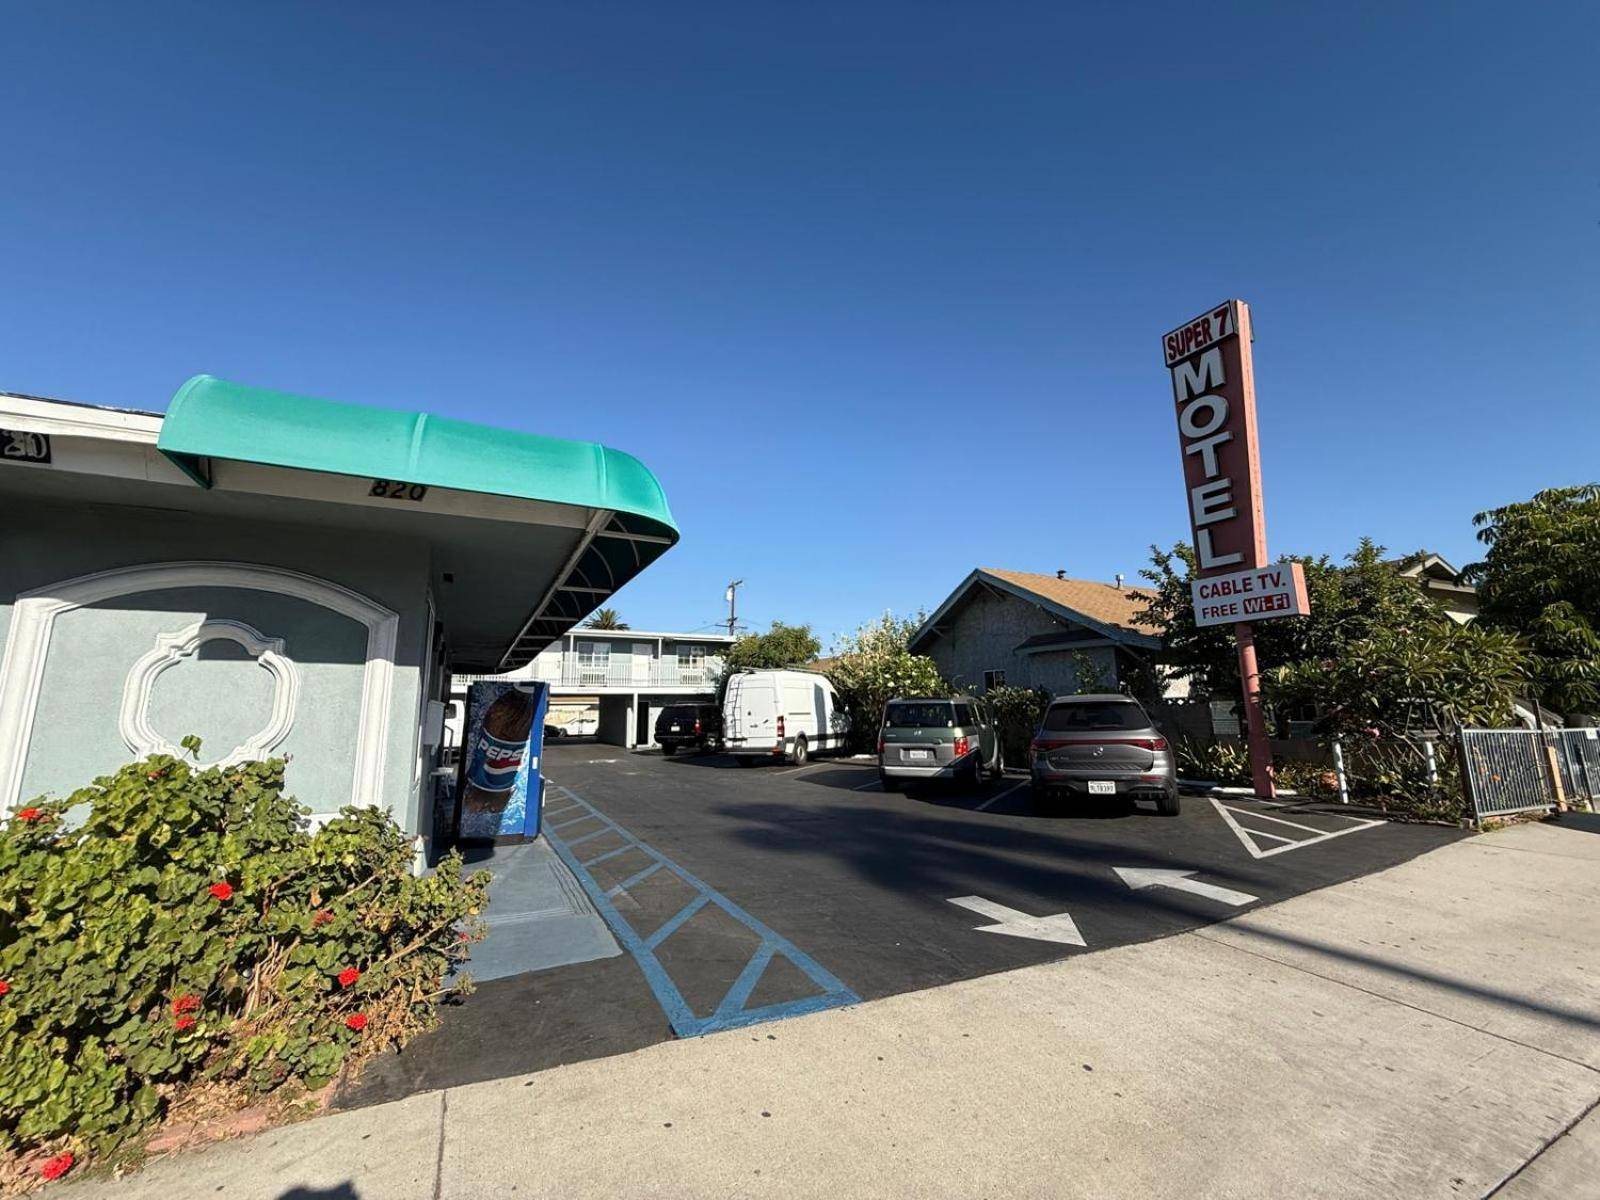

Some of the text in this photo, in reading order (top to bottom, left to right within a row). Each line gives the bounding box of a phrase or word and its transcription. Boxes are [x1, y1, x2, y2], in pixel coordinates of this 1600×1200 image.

[1167, 307, 1229, 361] SUPER 7
[1173, 346, 1244, 569] MOTEL
[372, 479, 426, 501] 820
[1200, 571, 1287, 599] CABLE TV.
[1201, 594, 1289, 619] FREE Wi-Fi
